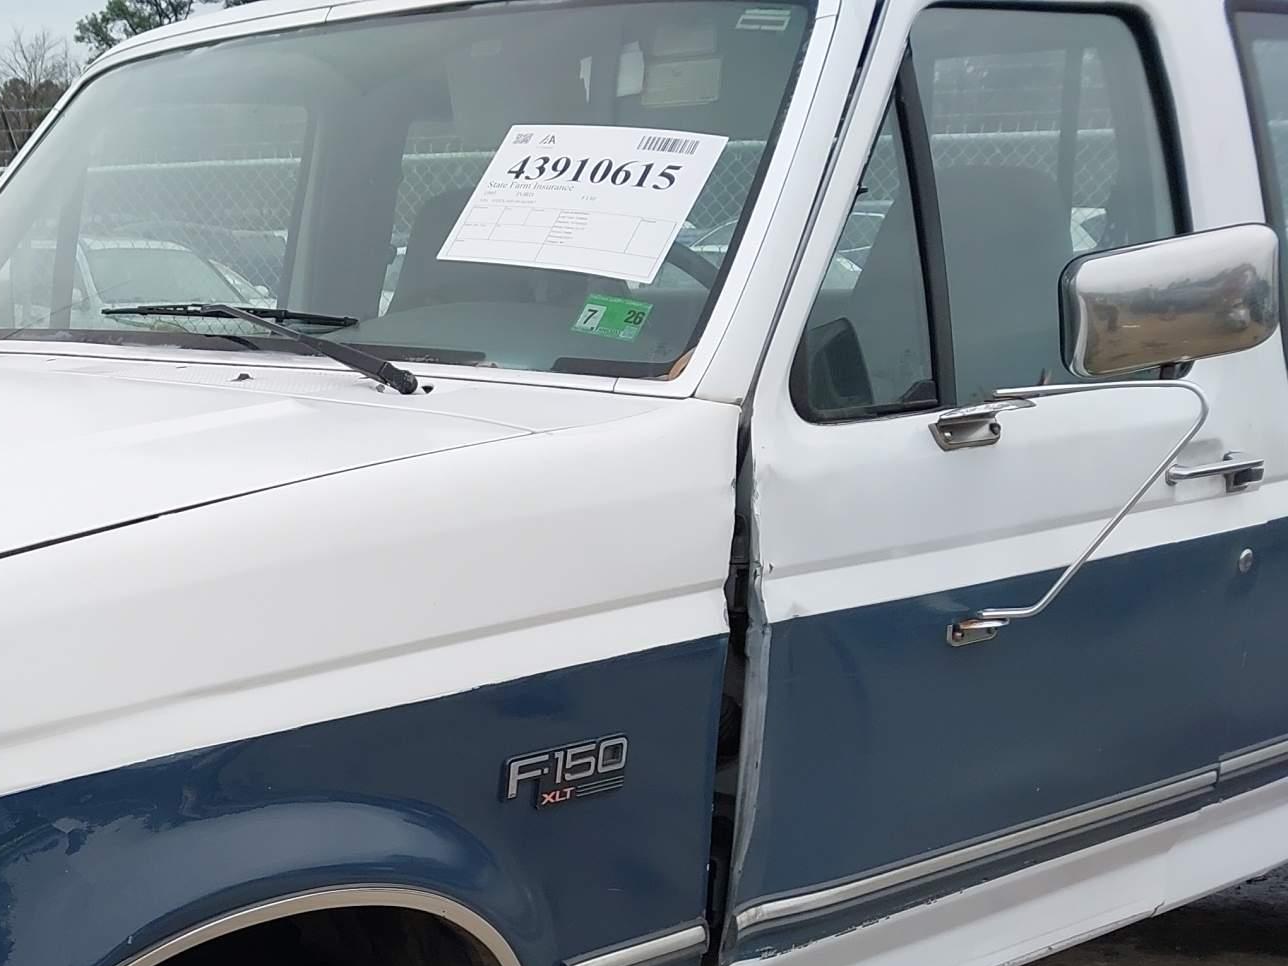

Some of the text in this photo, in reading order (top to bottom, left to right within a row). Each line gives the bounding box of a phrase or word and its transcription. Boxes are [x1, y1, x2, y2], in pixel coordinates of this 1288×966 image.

[507, 155, 683, 190] 43910615
[487, 181, 575, 192] State Farm Insurance
[583, 309, 645, 325] 7 26
[541, 787, 575, 805] XLT
